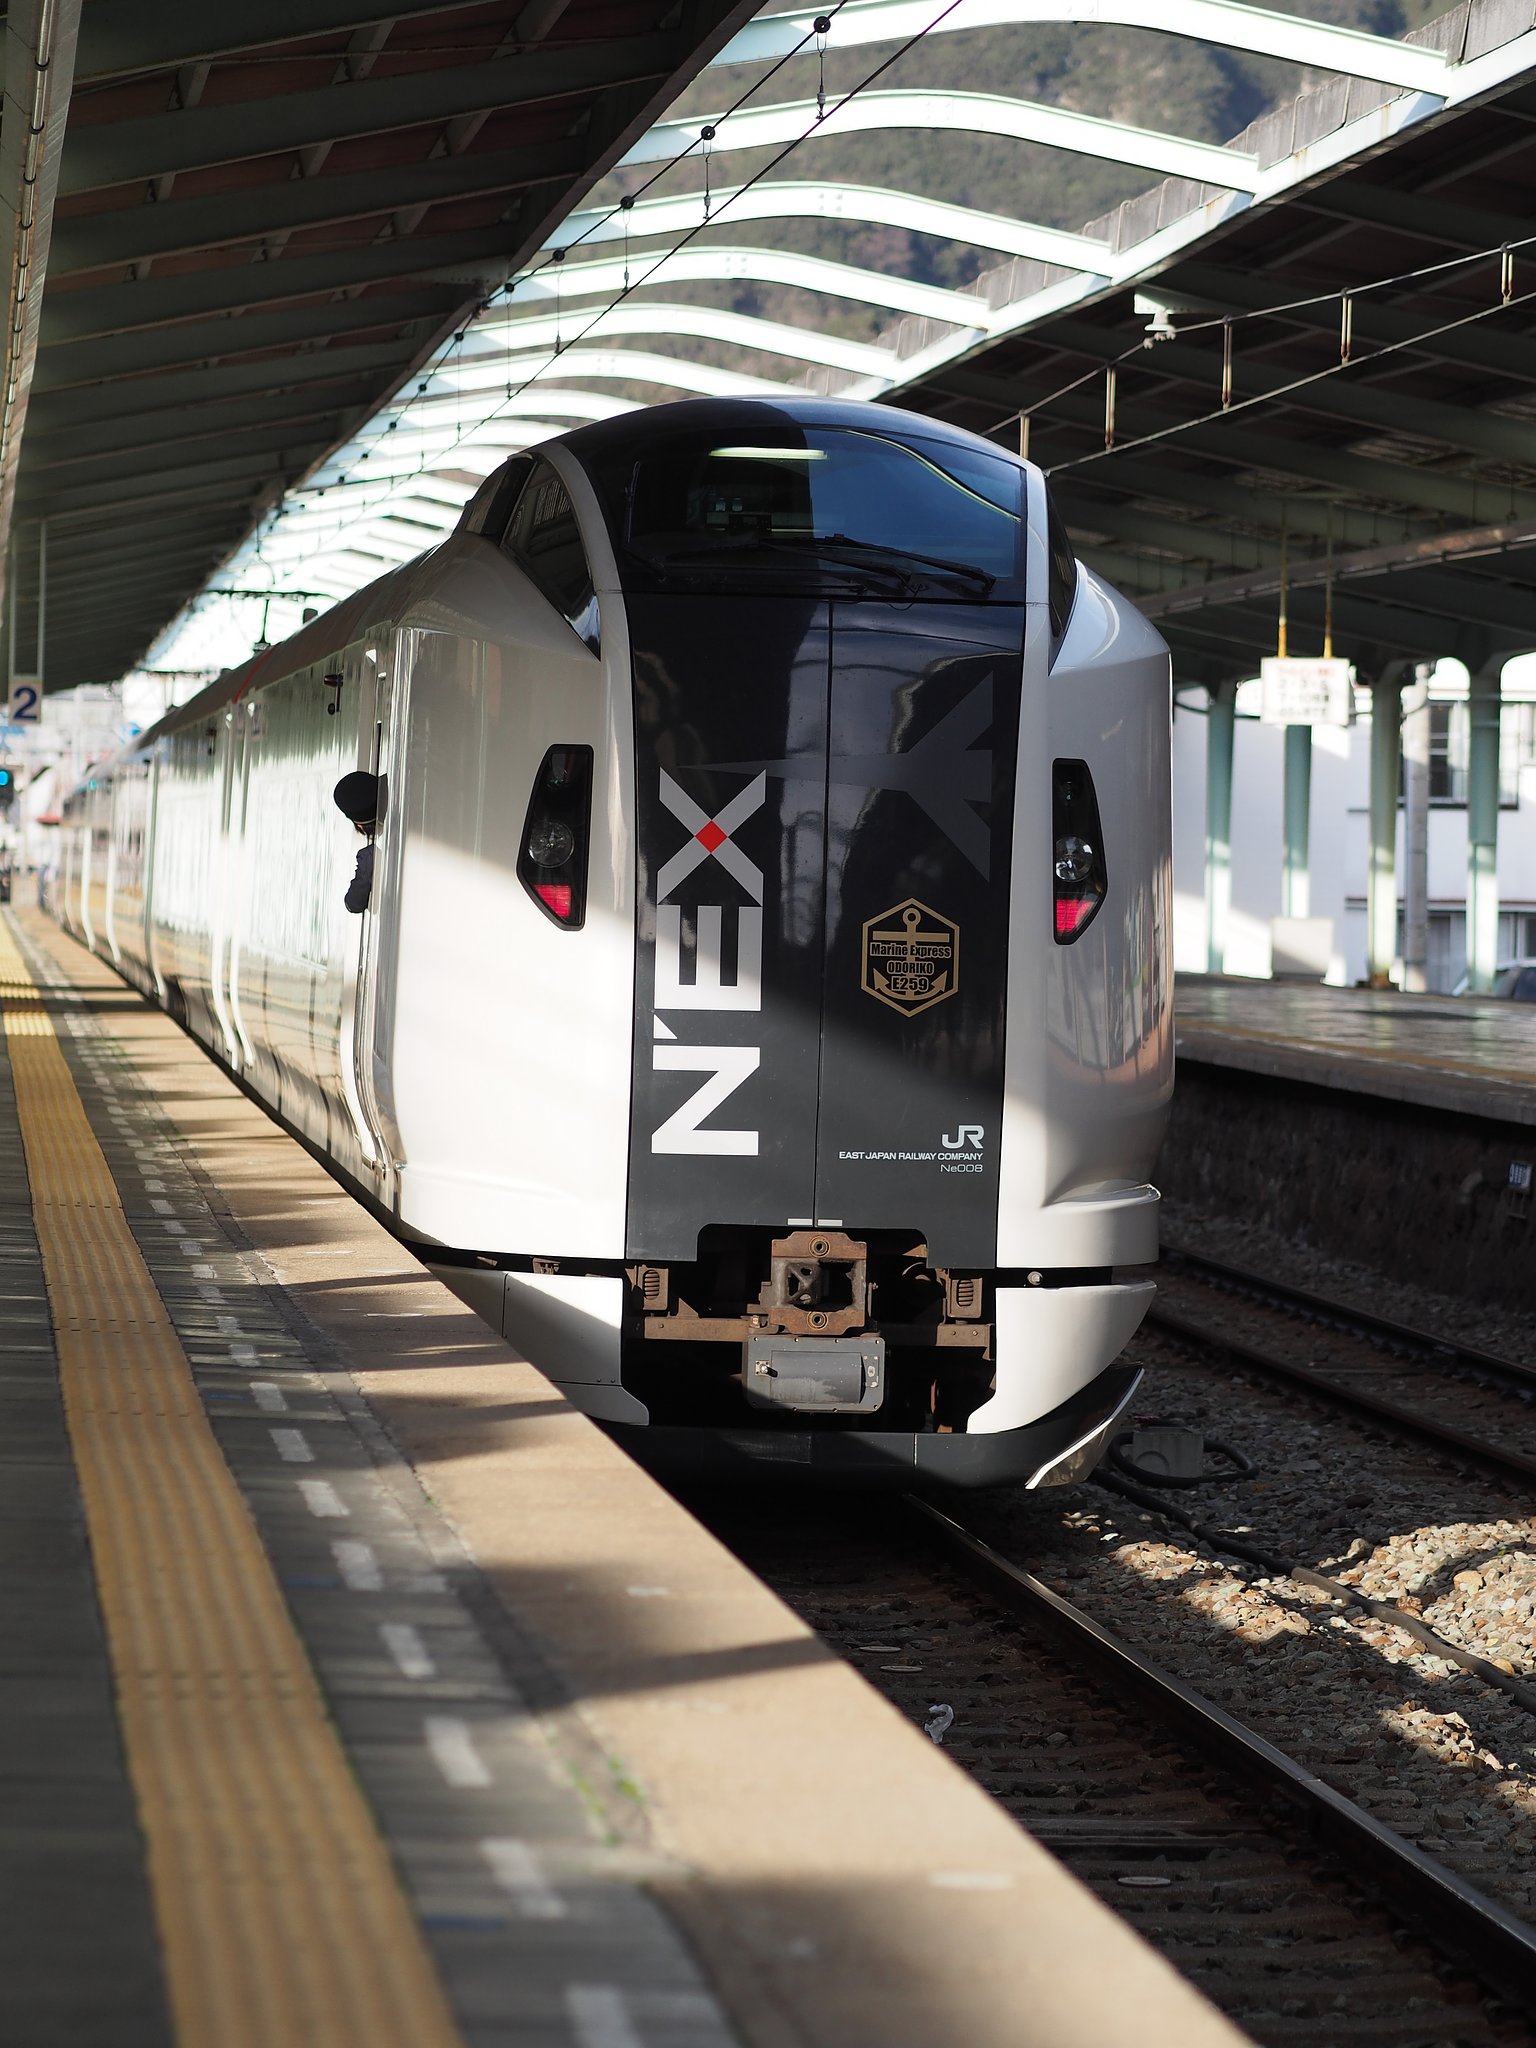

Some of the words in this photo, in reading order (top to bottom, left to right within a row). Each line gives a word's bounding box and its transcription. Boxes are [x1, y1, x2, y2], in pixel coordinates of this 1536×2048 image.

[14, 687, 38, 719] 2
[870, 943, 908, 956] Marine
[910, 945, 951, 958] Express
[887, 961, 934, 975] ODORIKO
[892, 977, 928, 991] E259
[941, 1125, 985, 1149] JR
[839, 1151, 865, 1160] EAST
[865, 1152, 896, 1160] JAPAN
[898, 1152, 937, 1161] RAILWAY
[937, 1152, 983, 1161] COMPANY
[940, 1164, 983, 1173] Ne008
